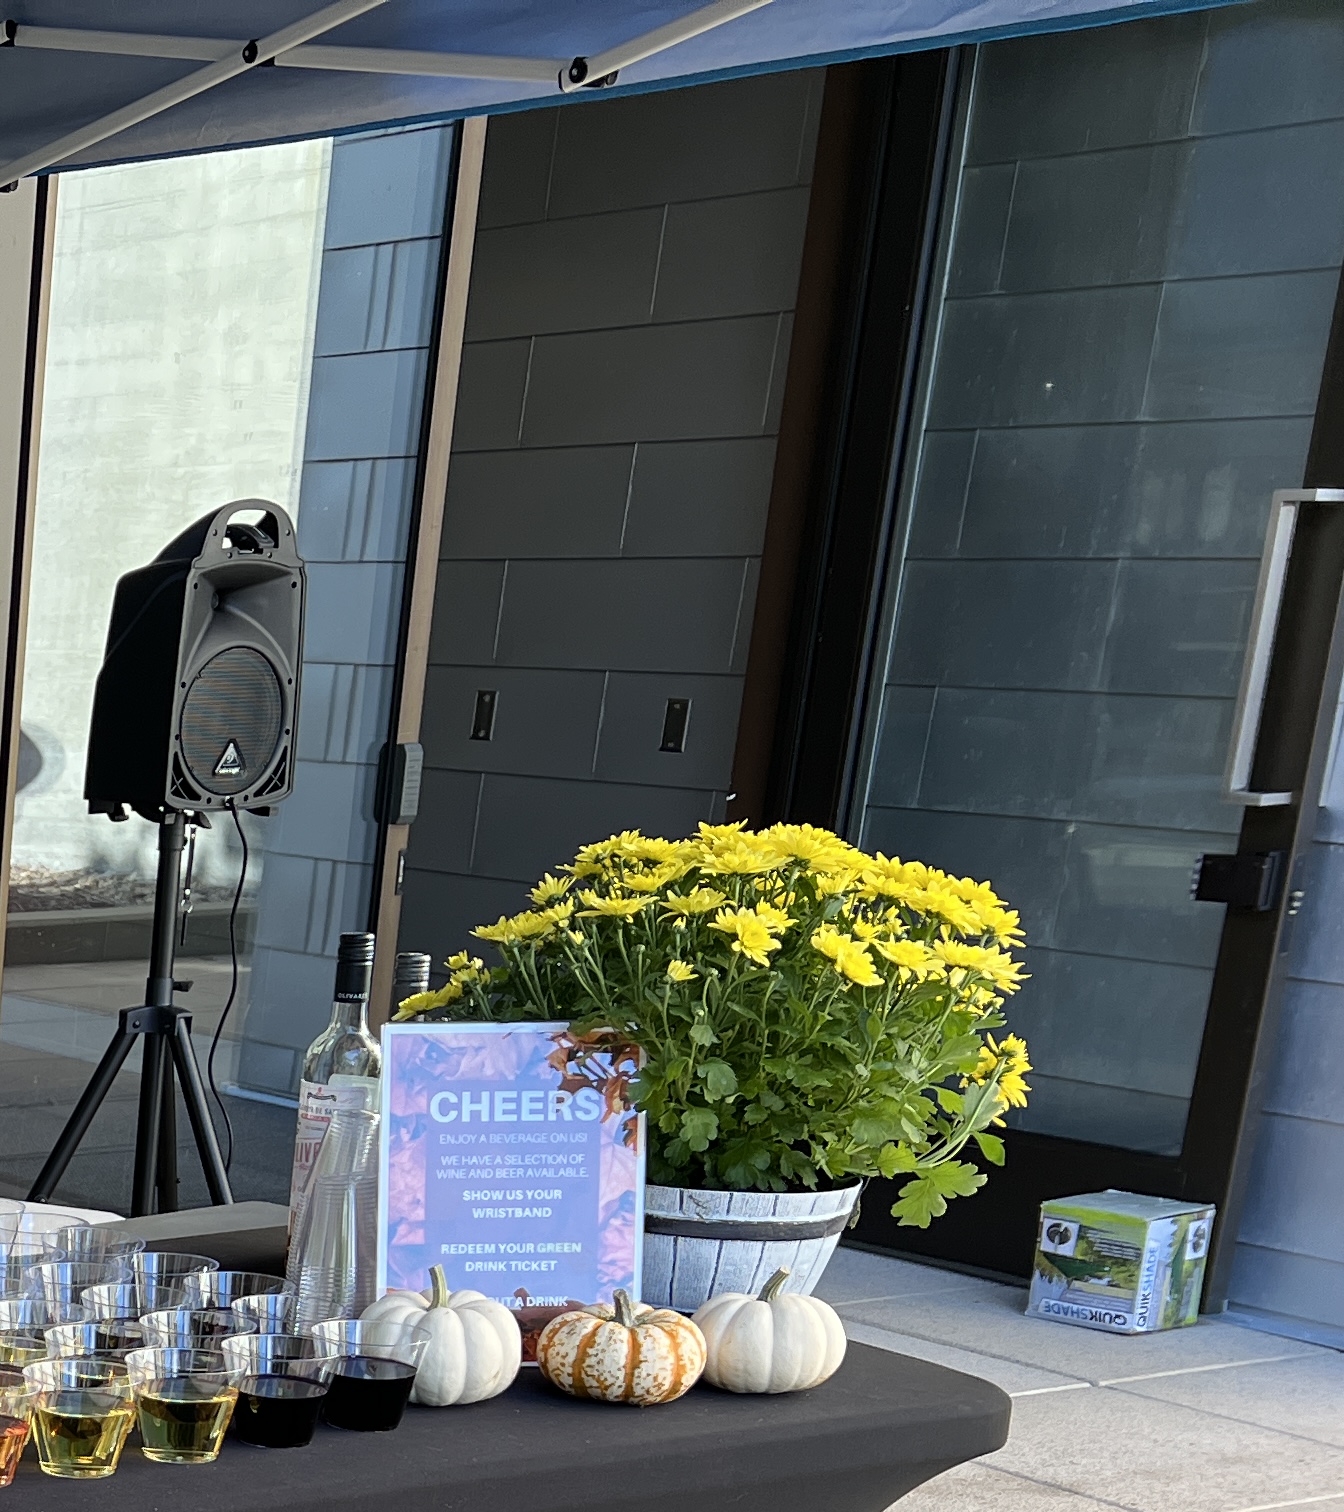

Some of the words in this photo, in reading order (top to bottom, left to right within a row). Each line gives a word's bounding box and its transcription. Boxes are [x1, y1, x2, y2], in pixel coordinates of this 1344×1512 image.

[429, 1086, 601, 1123] CHEERS
[439, 1133, 477, 1145] ENJOY
[479, 1133, 488, 1145] A
[489, 1132, 548, 1144] BEVERAGE
[550, 1132, 568, 1143] ON
[569, 1132, 588, 1143] US!
[441, 1154, 460, 1166] WE
[461, 1155, 492, 1166] HAVE
[493, 1154, 503, 1165] A
[505, 1154, 567, 1165] SELECTION
[569, 1153, 585, 1164] OF
[436, 1168, 467, 1180] WINE
[468, 1168, 494, 1179] AND
[496, 1168, 524, 1179] BEER
[525, 1167, 589, 1178] AVAILABLE.
[462, 1190, 506, 1201] SHOW
[507, 1190, 524, 1200] US
[525, 1189, 562, 1200] YOUR
[472, 1207, 552, 1218] WRISTBAND
[441, 1243, 496, 1255] REDEEM
[498, 1243, 535, 1254] YOUR
[536, 1242, 582, 1253] GREEN
[465, 1261, 507, 1272] DRINK
[509, 1260, 558, 1271] TICKET
[1136, 1245, 1159, 1328] QUIKSHADE
[514, 1297, 524, 1307] A
[526, 1296, 569, 1307] DRINK
[1043, 1301, 1128, 1327] QUIKSHADE
